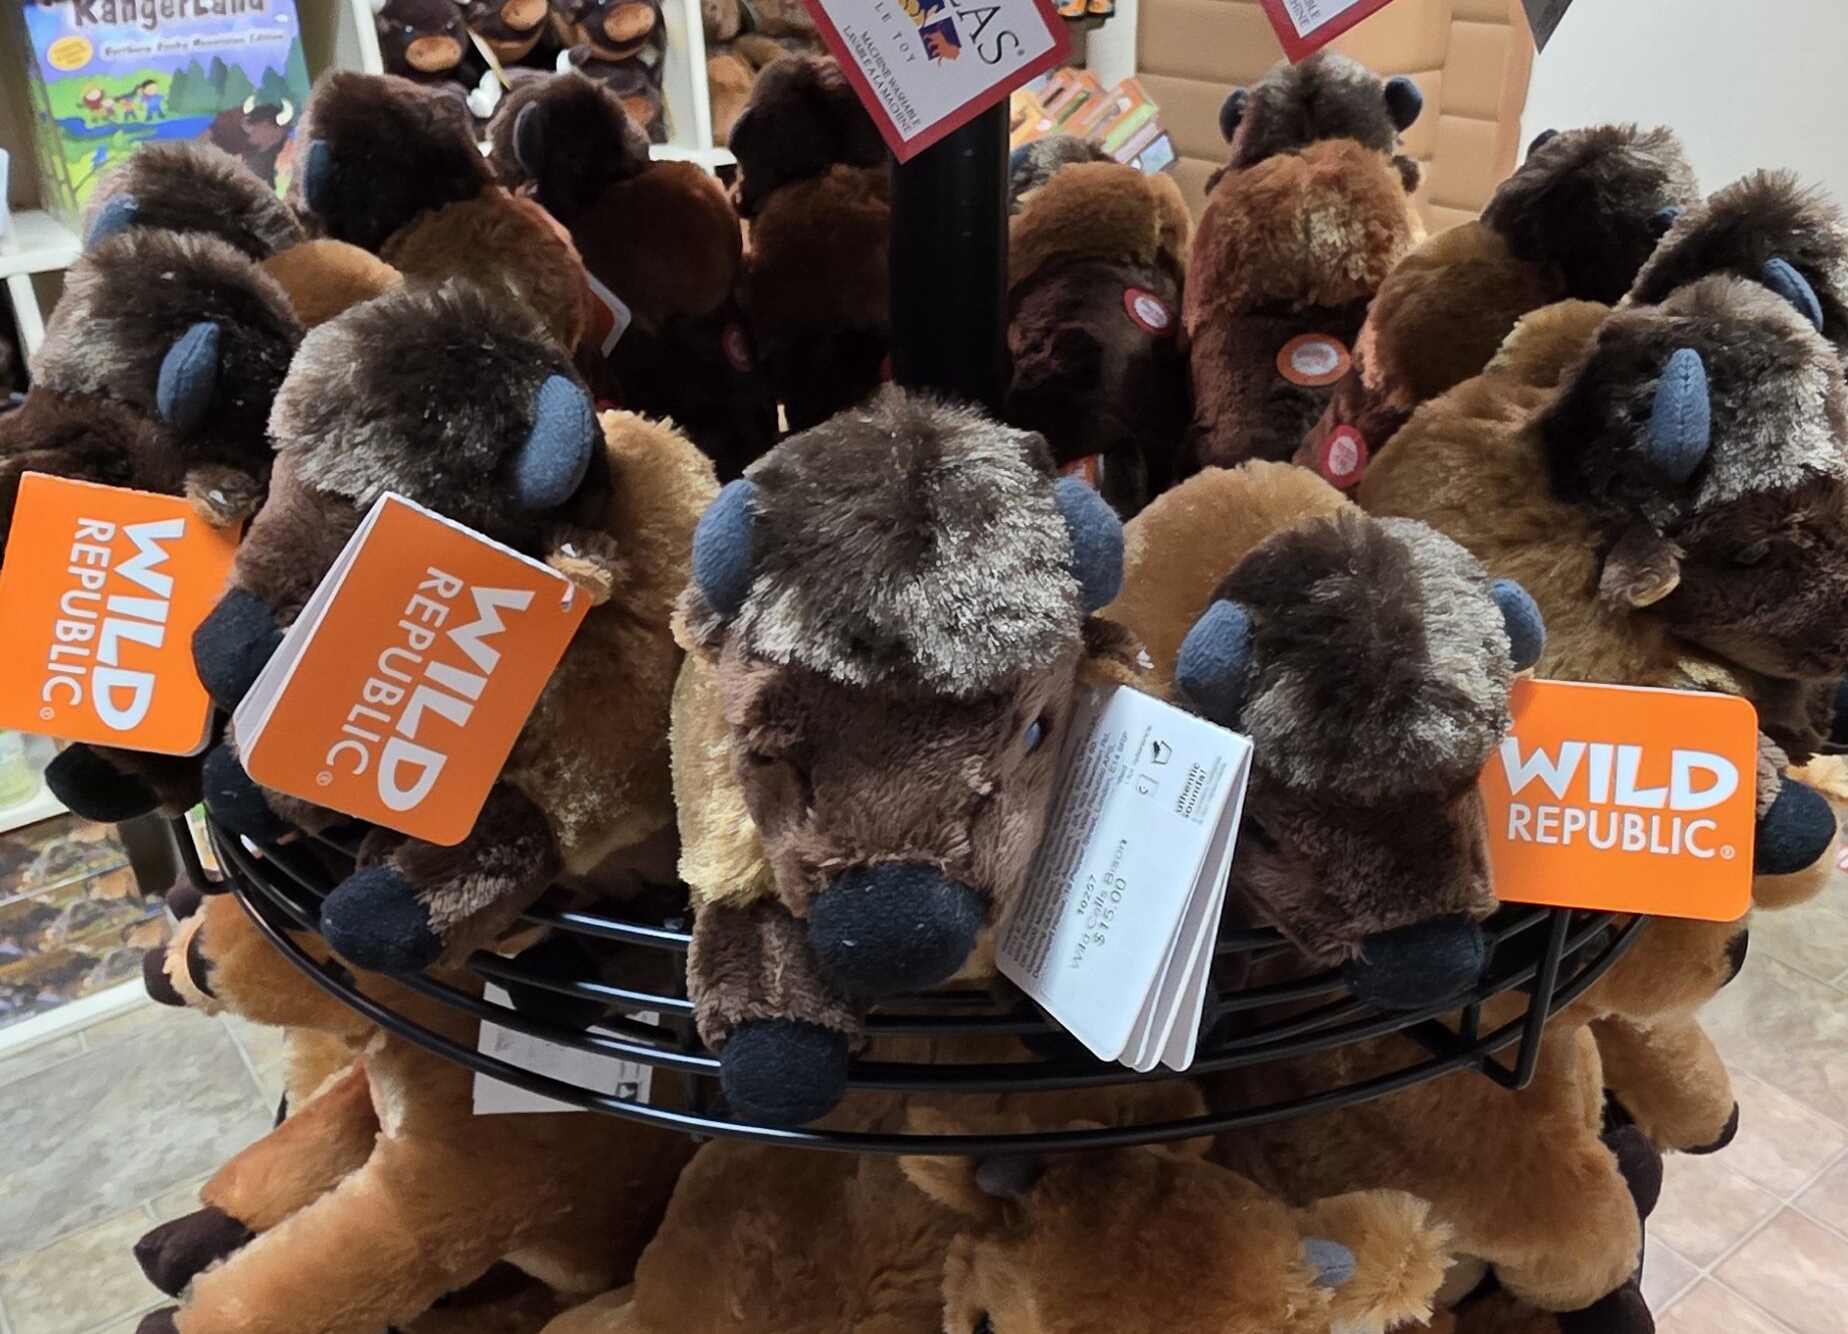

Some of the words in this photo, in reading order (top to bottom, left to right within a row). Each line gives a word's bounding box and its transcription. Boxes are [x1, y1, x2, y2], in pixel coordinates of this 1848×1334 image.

[842, 24, 872, 67] LAVABLE
[871, 73, 885, 90] LA
[879, 86, 911, 134] MACHINE
[859, 30, 893, 80] MACHINE
[886, 76, 921, 128] WASHABLE
[892, 31, 916, 65] TOY
[91, 517, 185, 731] WILD
[377, 586, 536, 811] WILD
[1174, 761, 1200, 814] uthentic
[1501, 736, 1739, 810] WILD
[1069, 932, 1090, 970] Wild
[1084, 888, 1107, 930] Calls
[1102, 837, 1127, 885] Bison
[1076, 873, 1098, 916] 10257
[1091, 876, 1127, 948] $15.00
